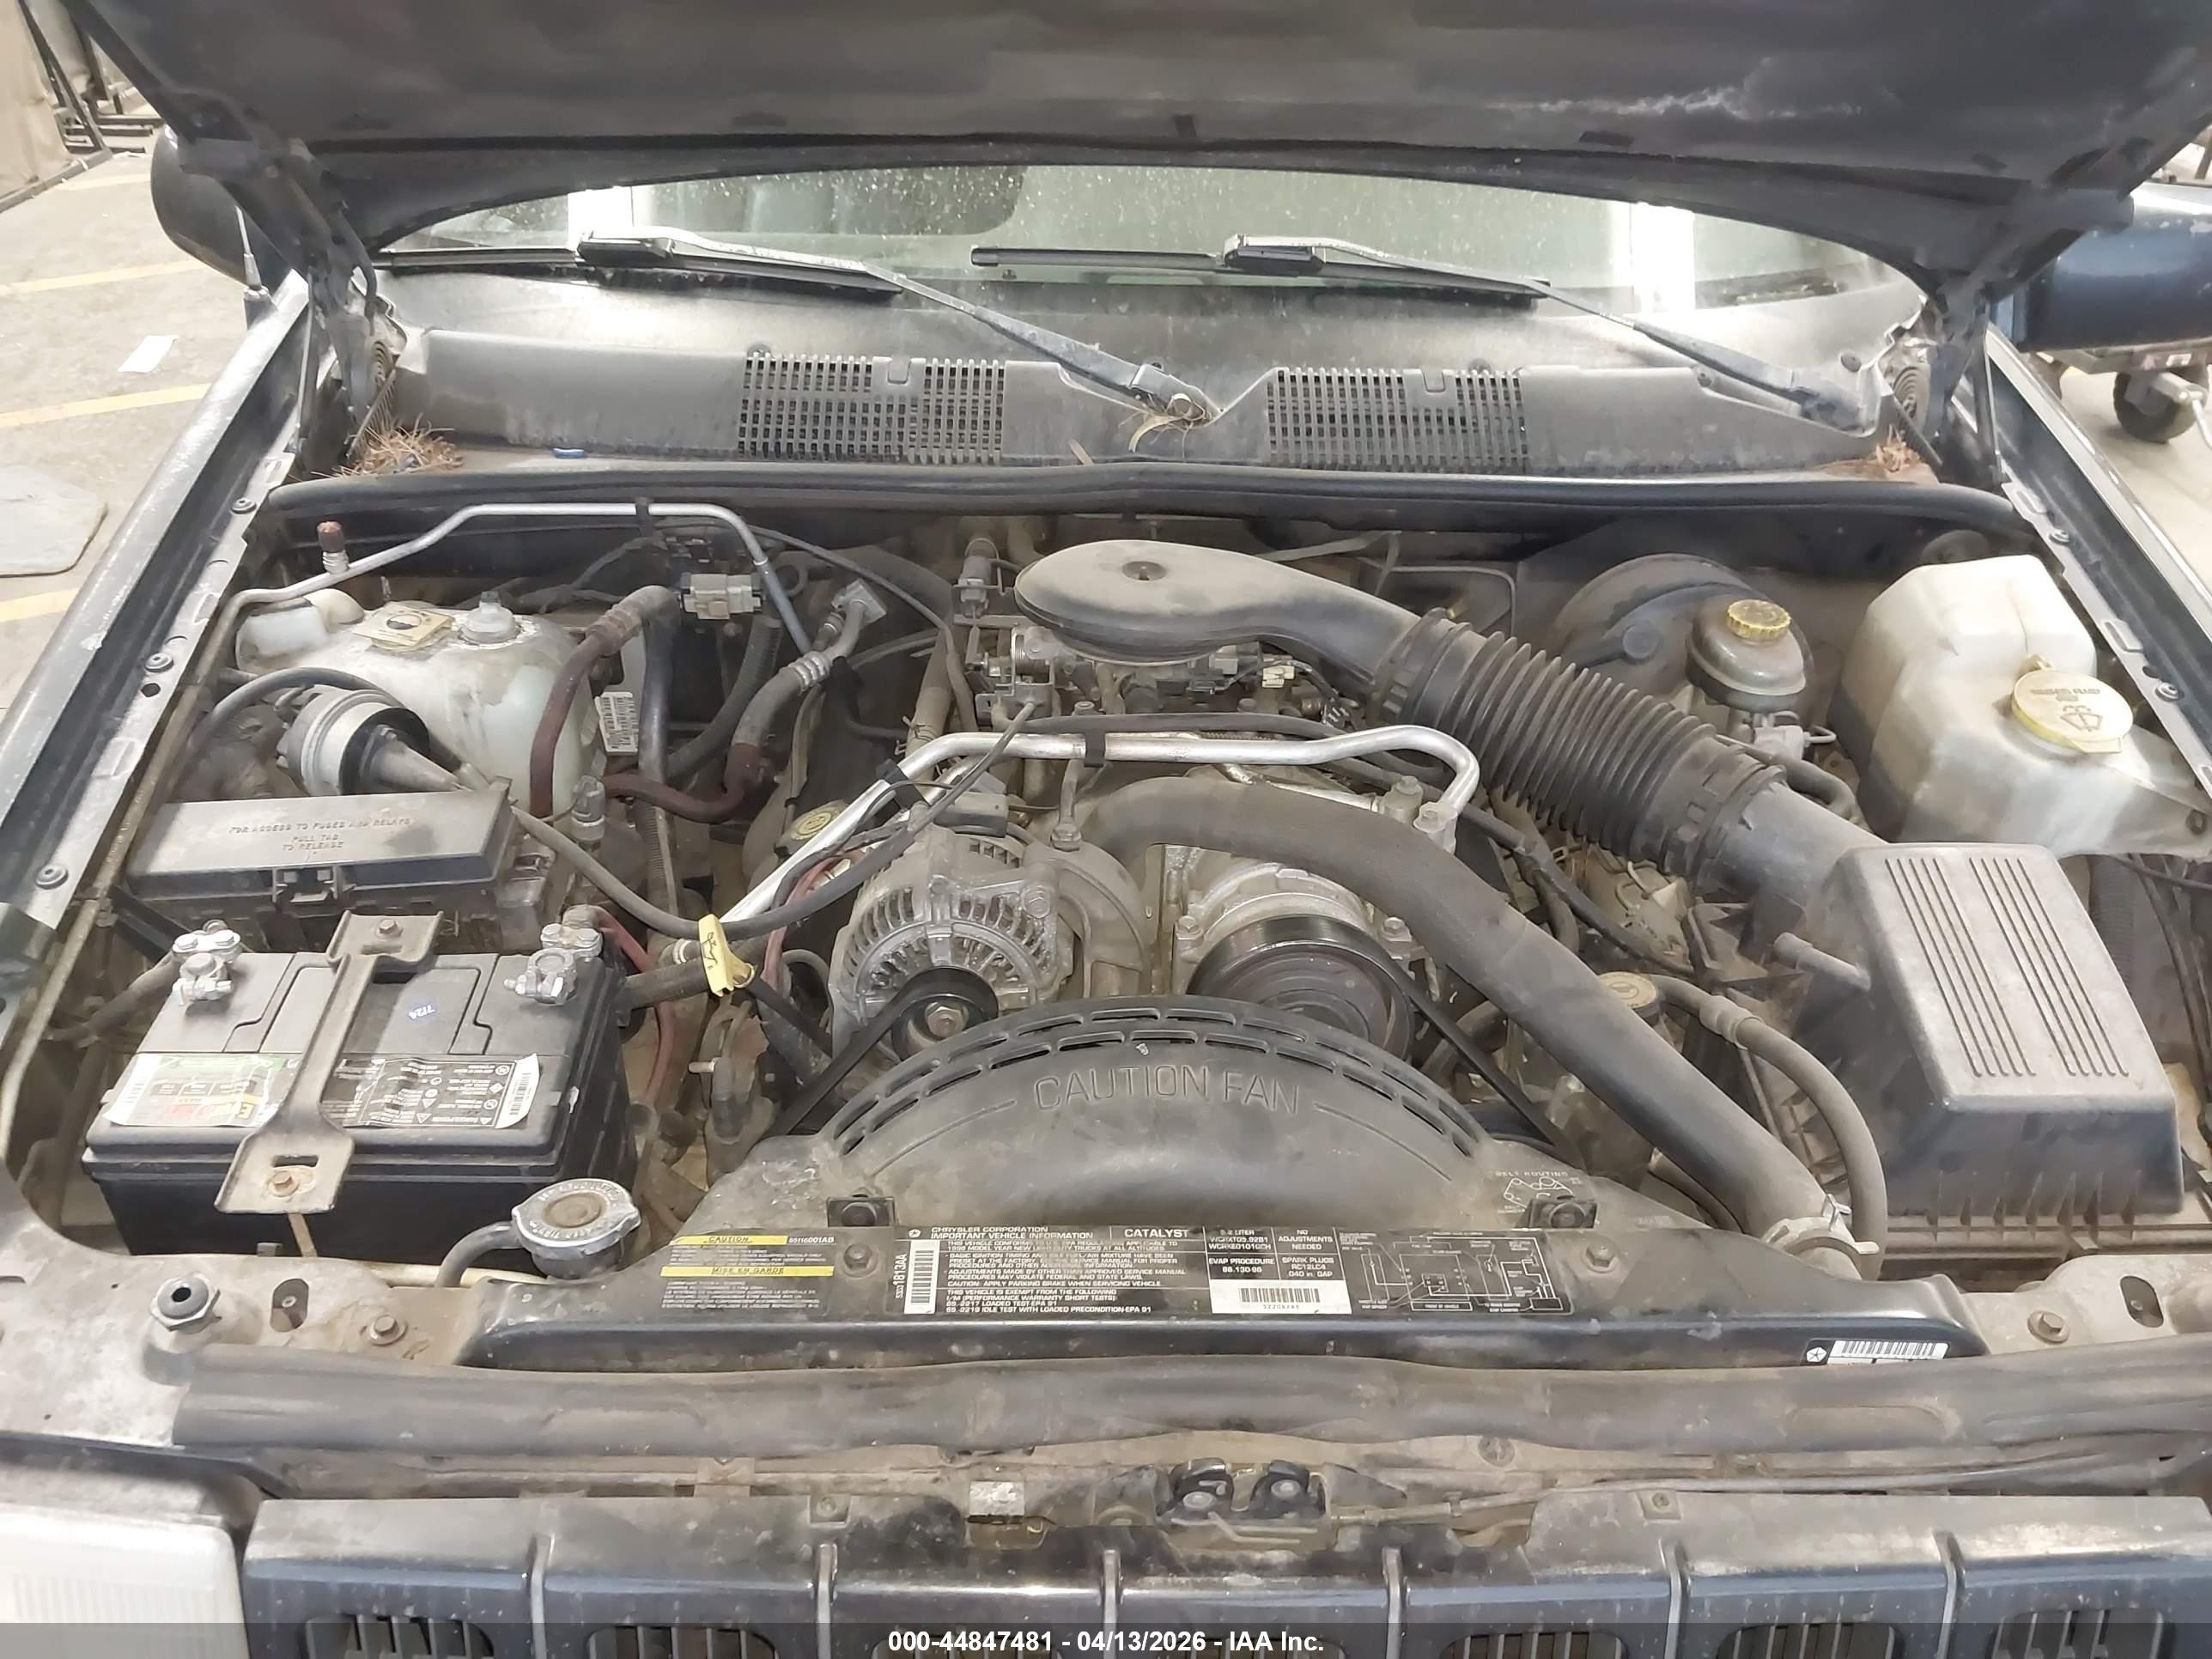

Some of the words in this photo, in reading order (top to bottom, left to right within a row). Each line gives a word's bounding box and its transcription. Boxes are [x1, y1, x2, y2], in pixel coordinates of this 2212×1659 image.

[252, 823, 292, 833] ACCESS
[312, 821, 345, 830] FUSES
[348, 819, 369, 829] AND
[372, 817, 411, 827] RELAYS
[299, 842, 344, 850] RELEASE
[1034, 1064, 1210, 1111] CAUTION
[1223, 1070, 1299, 1115] FAN
[1124, 1229, 1189, 1238] CATALYST
